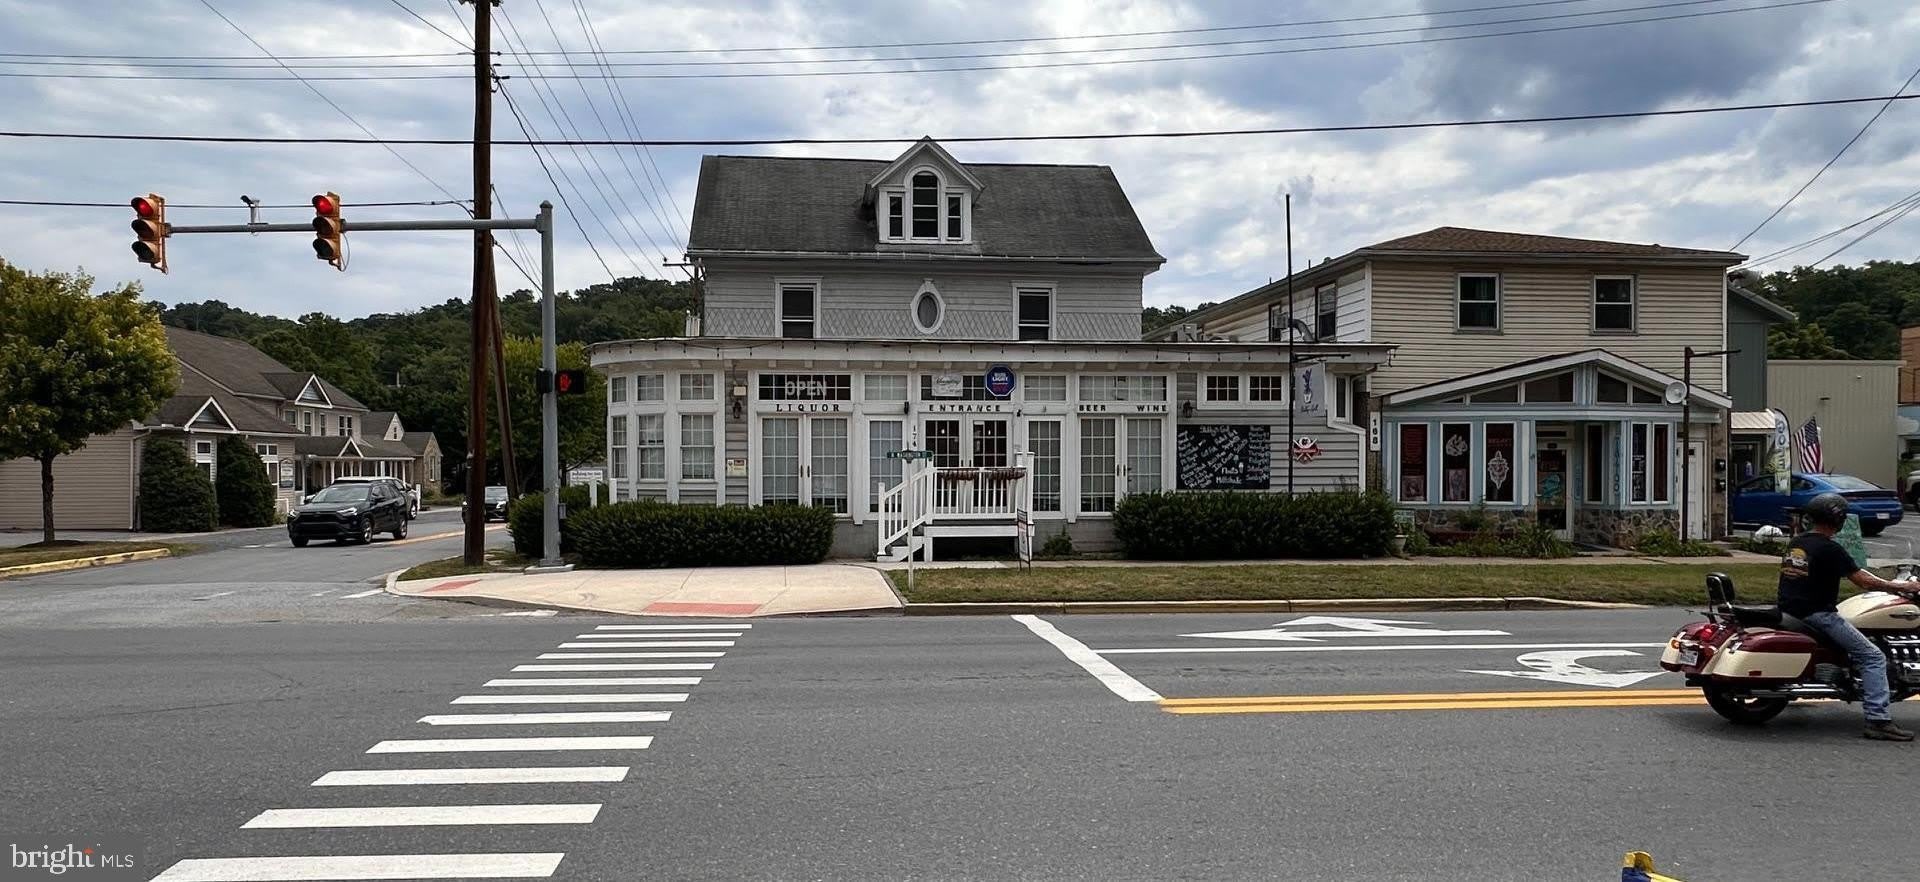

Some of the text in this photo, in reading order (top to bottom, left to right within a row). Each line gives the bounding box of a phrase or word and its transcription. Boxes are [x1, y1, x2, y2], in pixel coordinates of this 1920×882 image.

[786, 381, 827, 396] OPEN
[776, 404, 839, 412] LIQUOR
[929, 404, 1000, 412] ENTRANCE
[1079, 404, 1167, 412] BEER WINE
